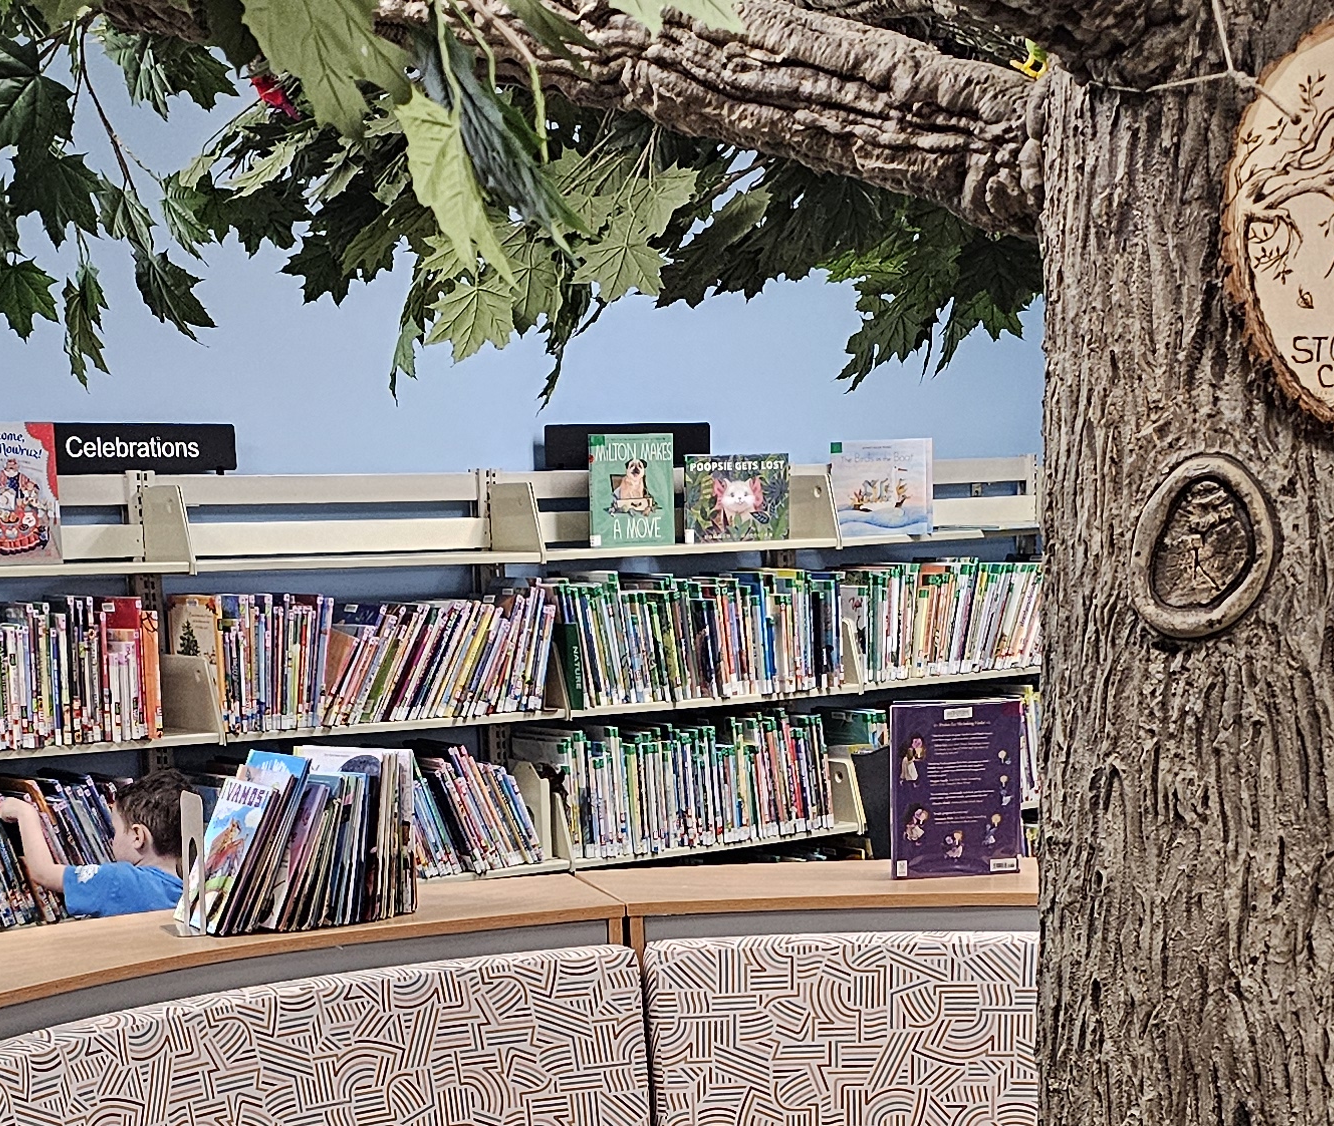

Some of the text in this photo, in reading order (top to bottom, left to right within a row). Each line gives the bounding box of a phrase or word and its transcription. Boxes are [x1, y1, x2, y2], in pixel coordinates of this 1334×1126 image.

[65, 435, 200, 459] Celebrations
[640, 442, 672, 461] MAKES
[689, 459, 786, 472] POOPSIE GETS LOST
[613, 516, 662, 539] A MOVE
[572, 645, 582, 690] NATURE
